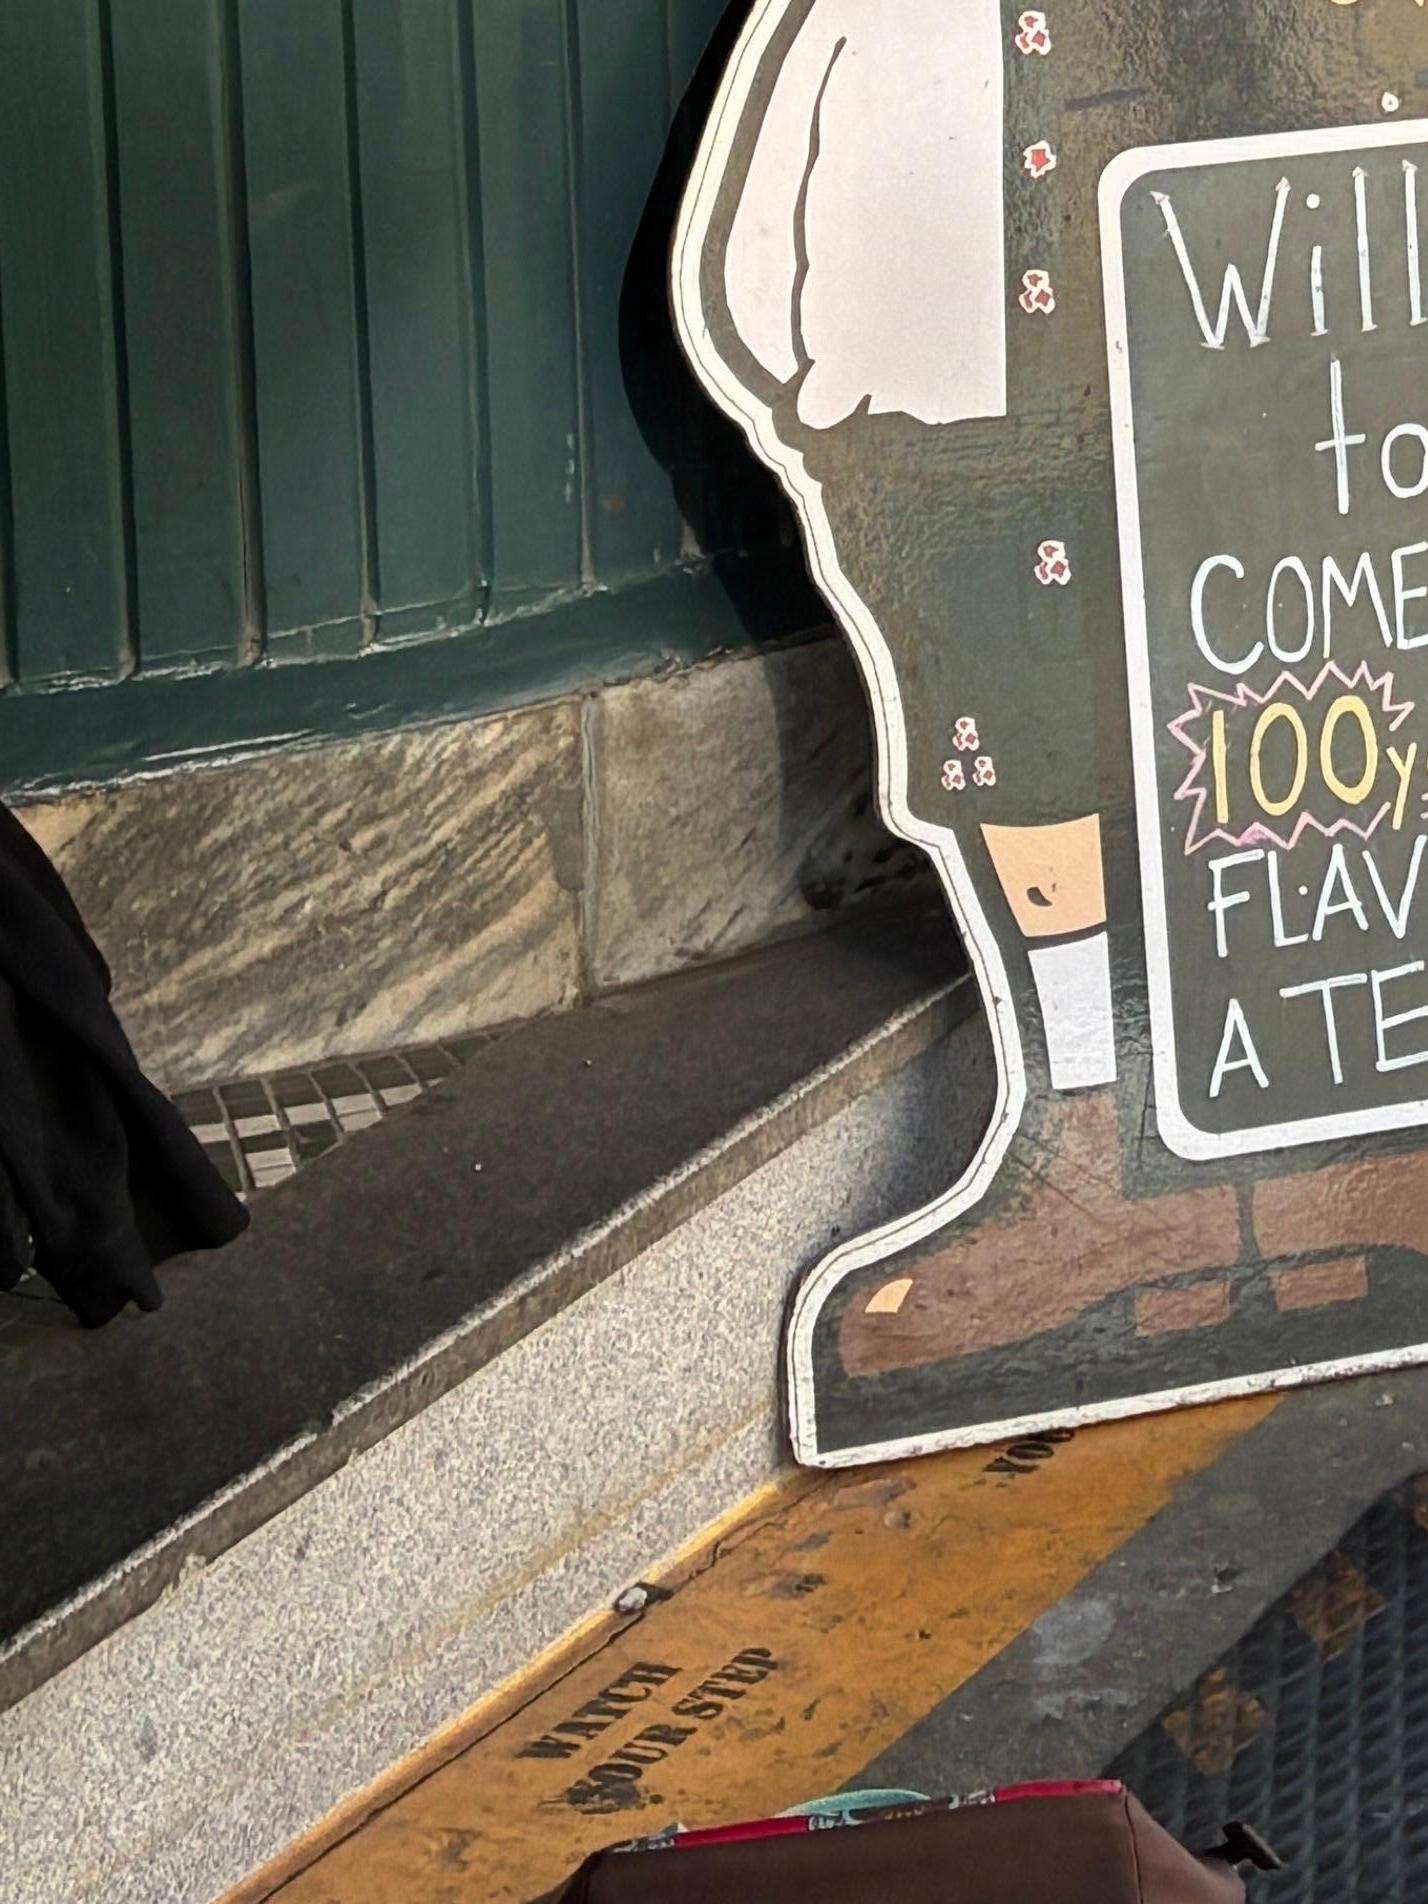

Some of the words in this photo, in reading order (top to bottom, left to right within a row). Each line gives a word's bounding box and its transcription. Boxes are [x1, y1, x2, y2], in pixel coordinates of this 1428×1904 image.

[1203, 694, 1389, 826] 100
[1207, 997, 1270, 1100] A
[514, 1661, 683, 1759] WATCH
[672, 1647, 779, 1720] STEP
